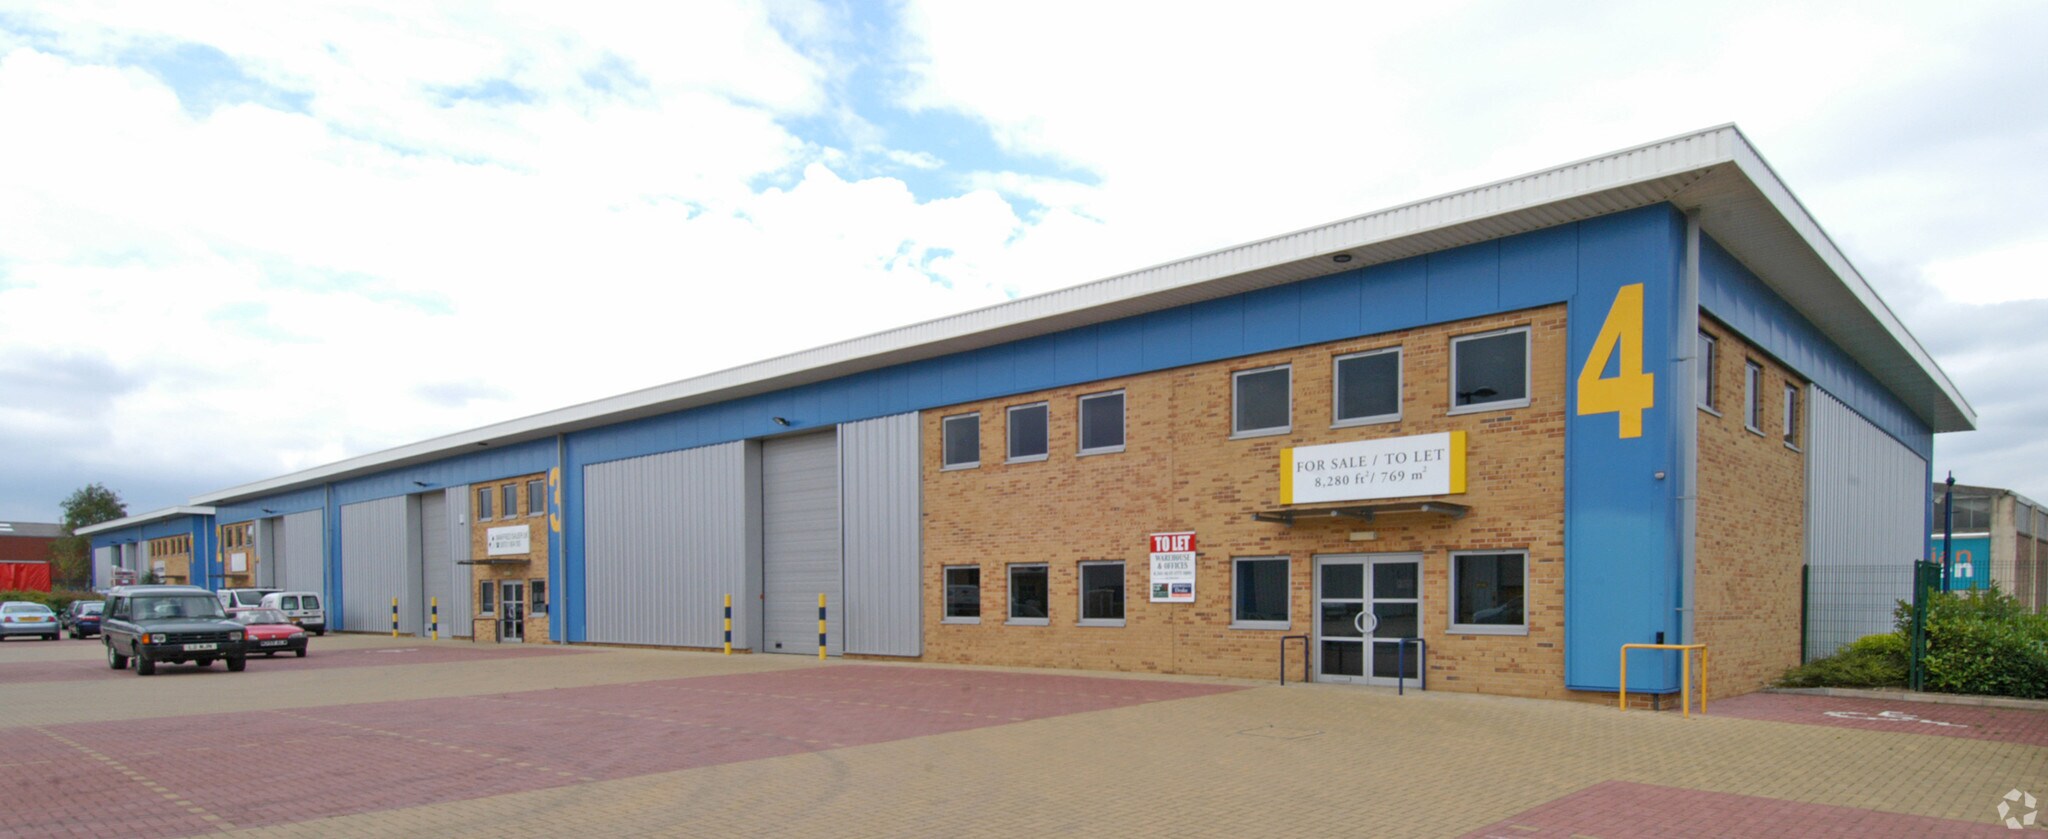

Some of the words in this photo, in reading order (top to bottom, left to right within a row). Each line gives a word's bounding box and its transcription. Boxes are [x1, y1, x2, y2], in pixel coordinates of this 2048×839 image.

[1577, 282, 1654, 439] 4
[1296, 460, 1325, 473] FOR
[1331, 455, 1367, 470] SALE
[1372, 454, 1378, 466] /
[1384, 452, 1407, 465] TO
[1414, 448, 1445, 463] LET
[1314, 475, 1350, 489] 8,280
[1381, 470, 1405, 483] 769
[549, 467, 560, 532] 3
[1154, 536, 1170, 552] TO
[1172, 535, 1191, 551] LET
[1155, 553, 1190, 561] WAREHOUSE
